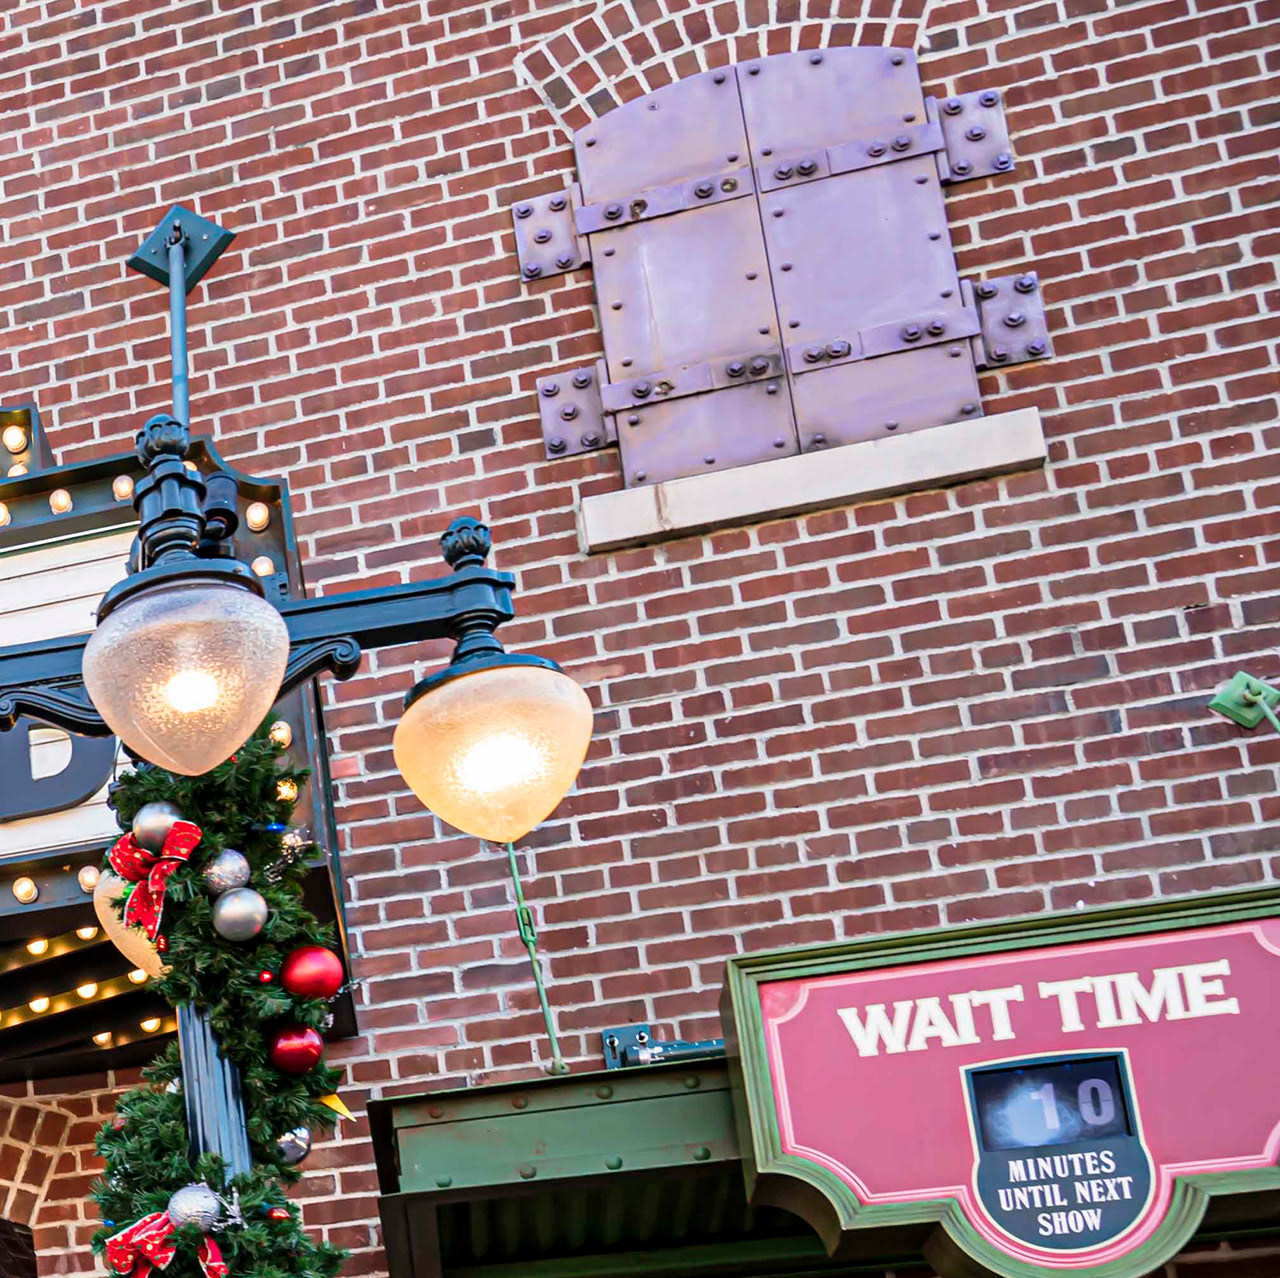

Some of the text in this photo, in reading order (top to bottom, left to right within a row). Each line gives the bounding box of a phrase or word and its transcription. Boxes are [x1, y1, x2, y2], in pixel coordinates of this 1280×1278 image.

[836, 959, 1240, 1058] WAIT TIME
[1008, 1150, 1117, 1183] MINUTES
[997, 1175, 1134, 1212] UNTIL NEXT
[1038, 1208, 1103, 1237] SHOW
